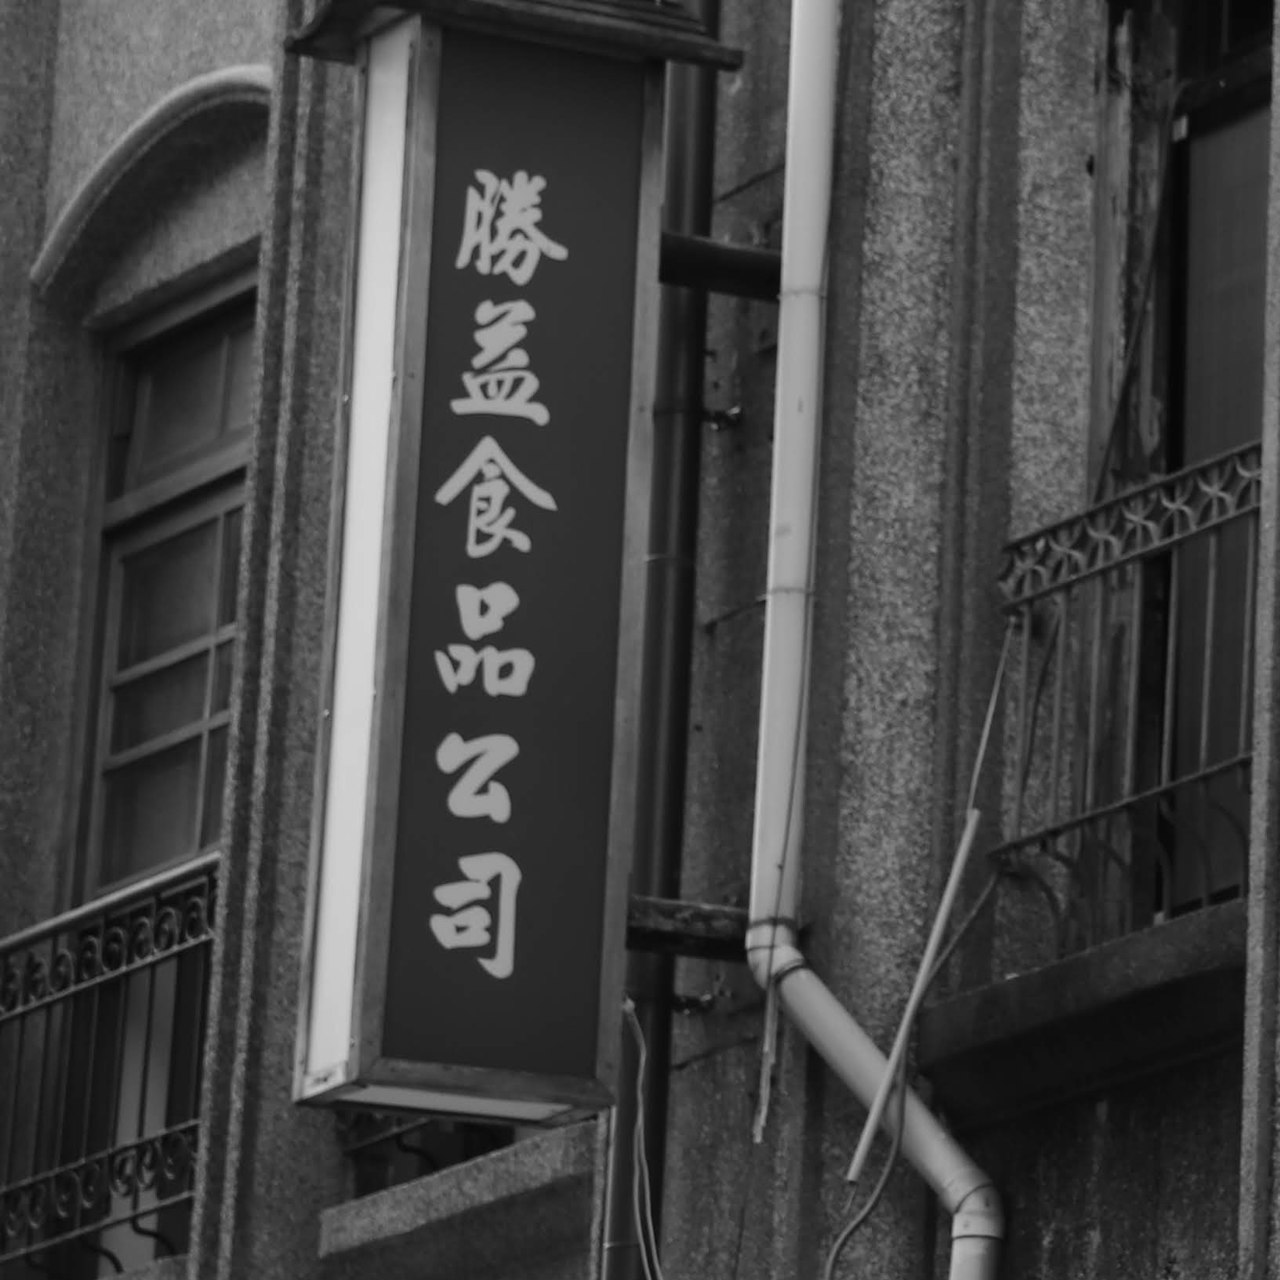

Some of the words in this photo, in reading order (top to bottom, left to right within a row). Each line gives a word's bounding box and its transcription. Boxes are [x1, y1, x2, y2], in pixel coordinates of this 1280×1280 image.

[430, 169, 569, 979] 勝益食品公司
